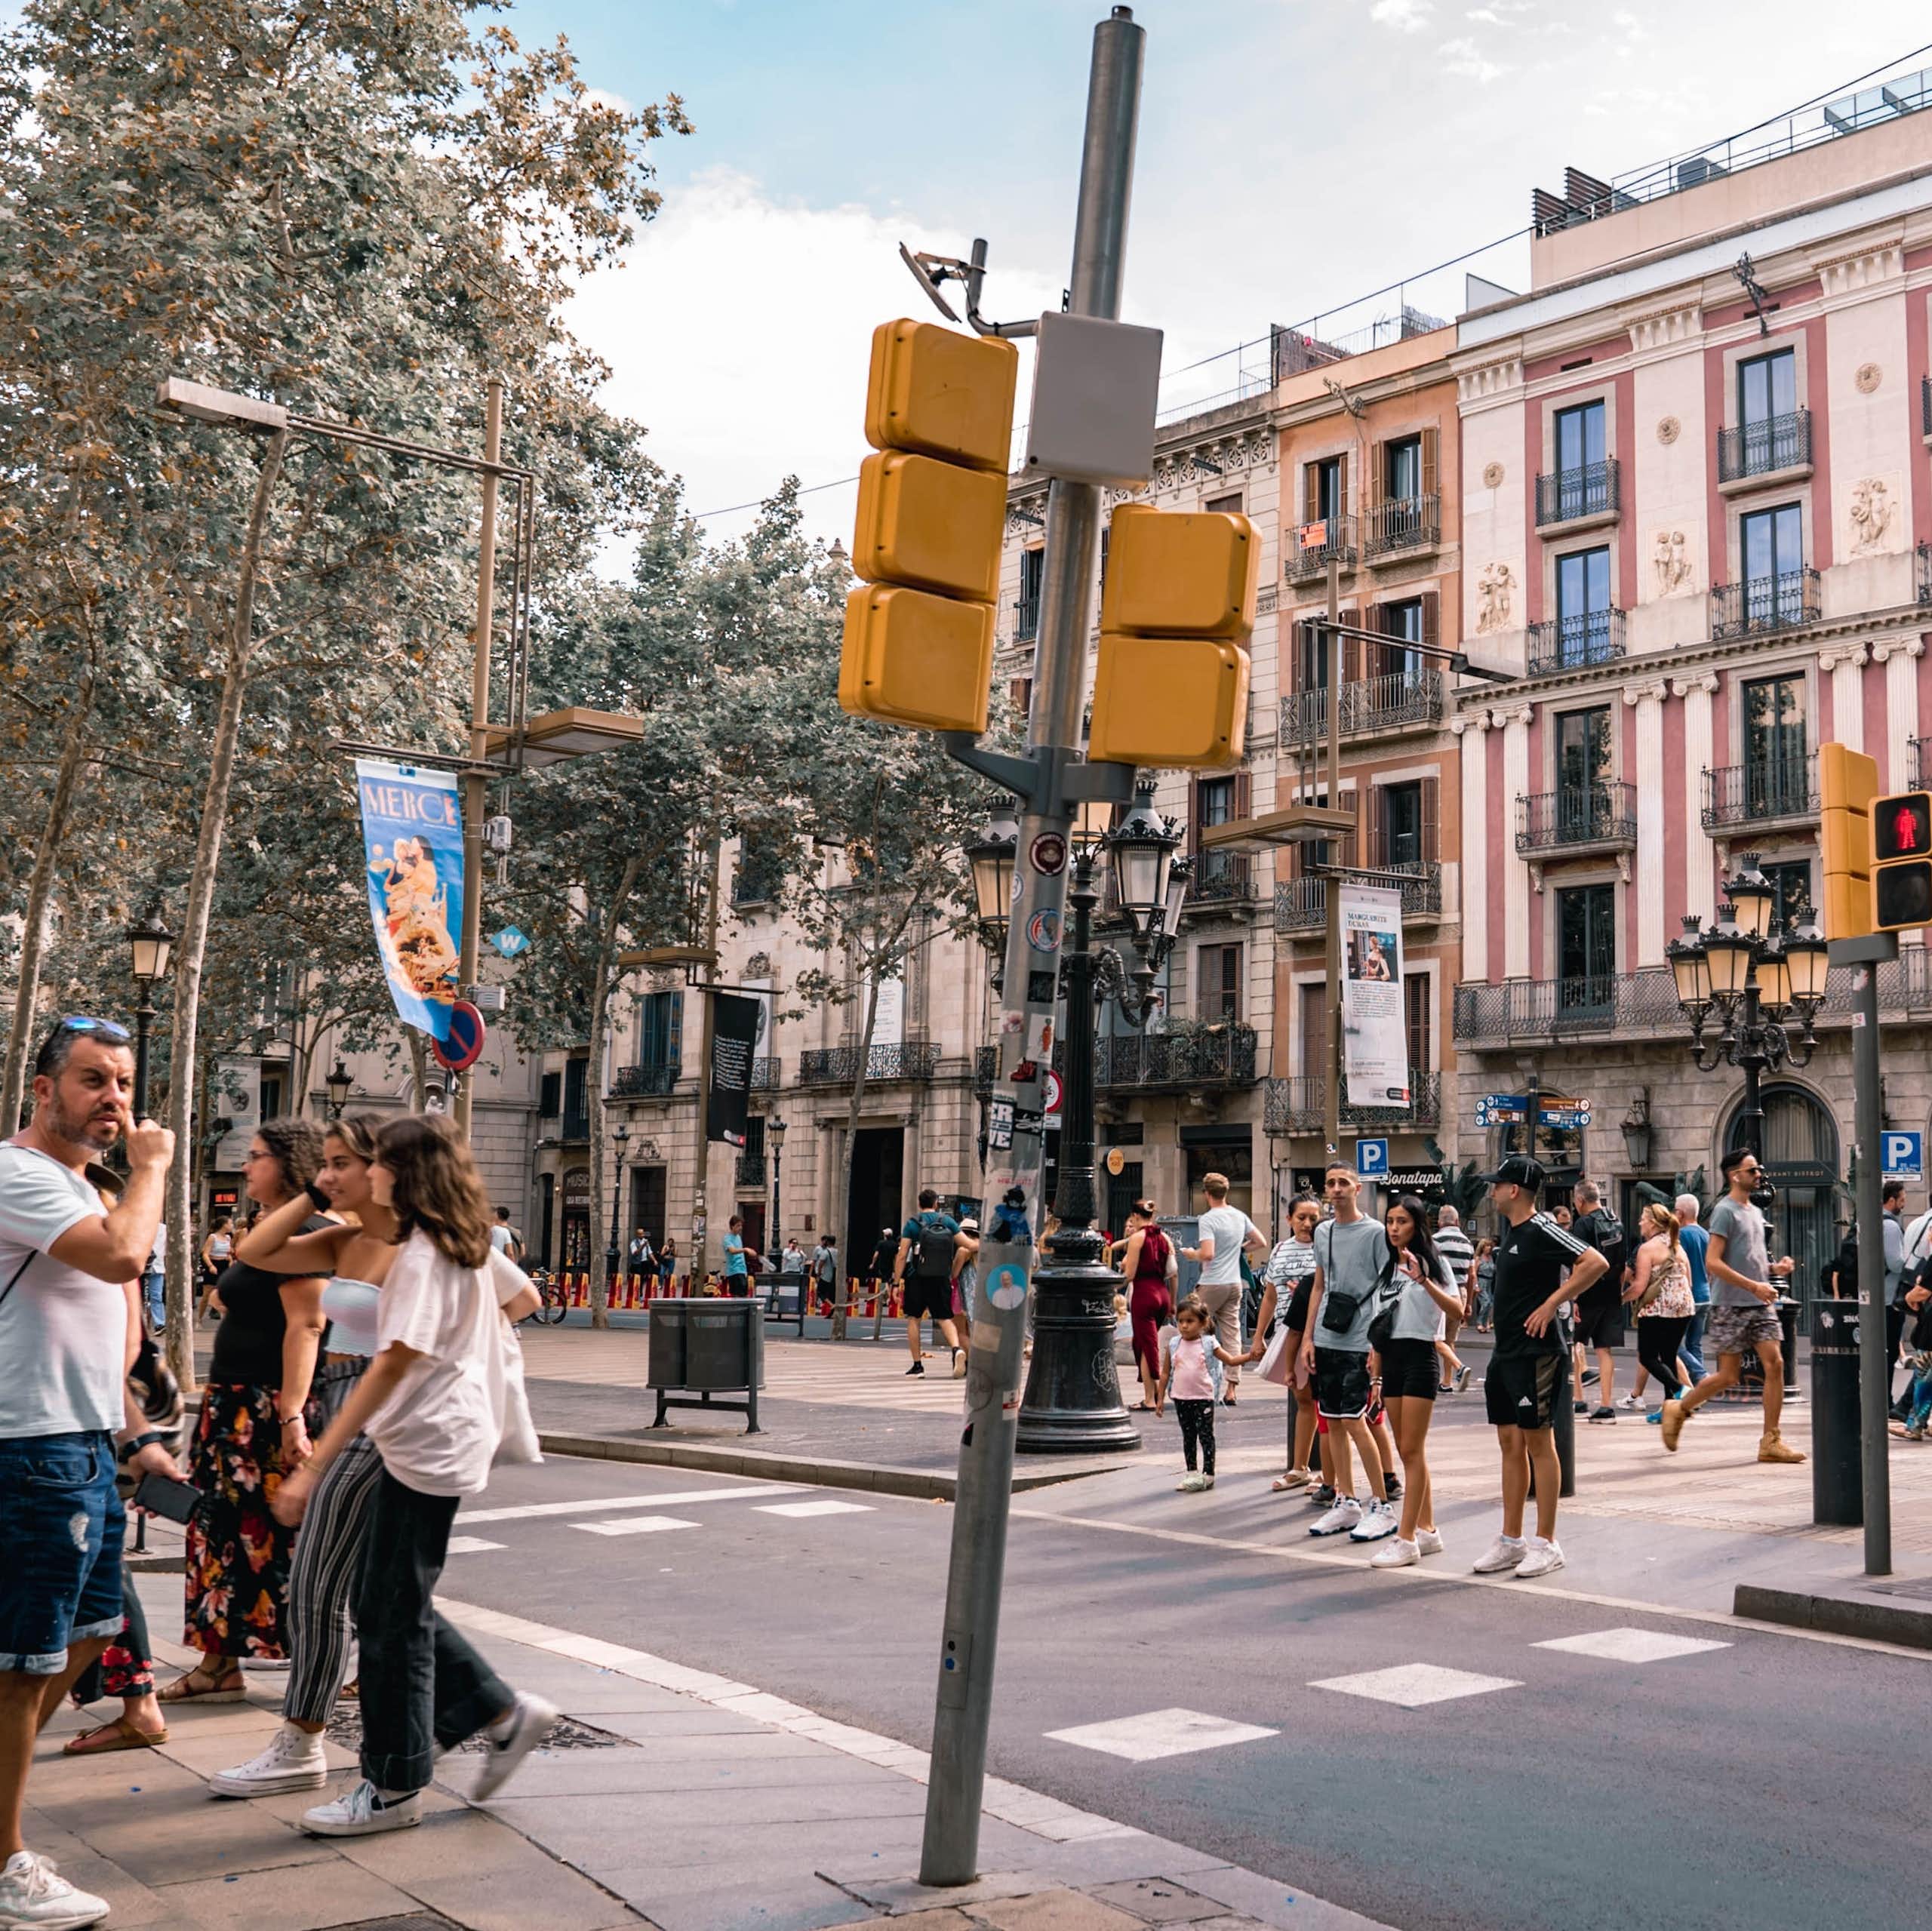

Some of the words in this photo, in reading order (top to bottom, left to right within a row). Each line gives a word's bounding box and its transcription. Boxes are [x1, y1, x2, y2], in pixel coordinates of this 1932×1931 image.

[1363, 1144, 1381, 1171] P
[1888, 1136, 1913, 1168] P
[1380, 1171, 1443, 1187] Bonatapa
